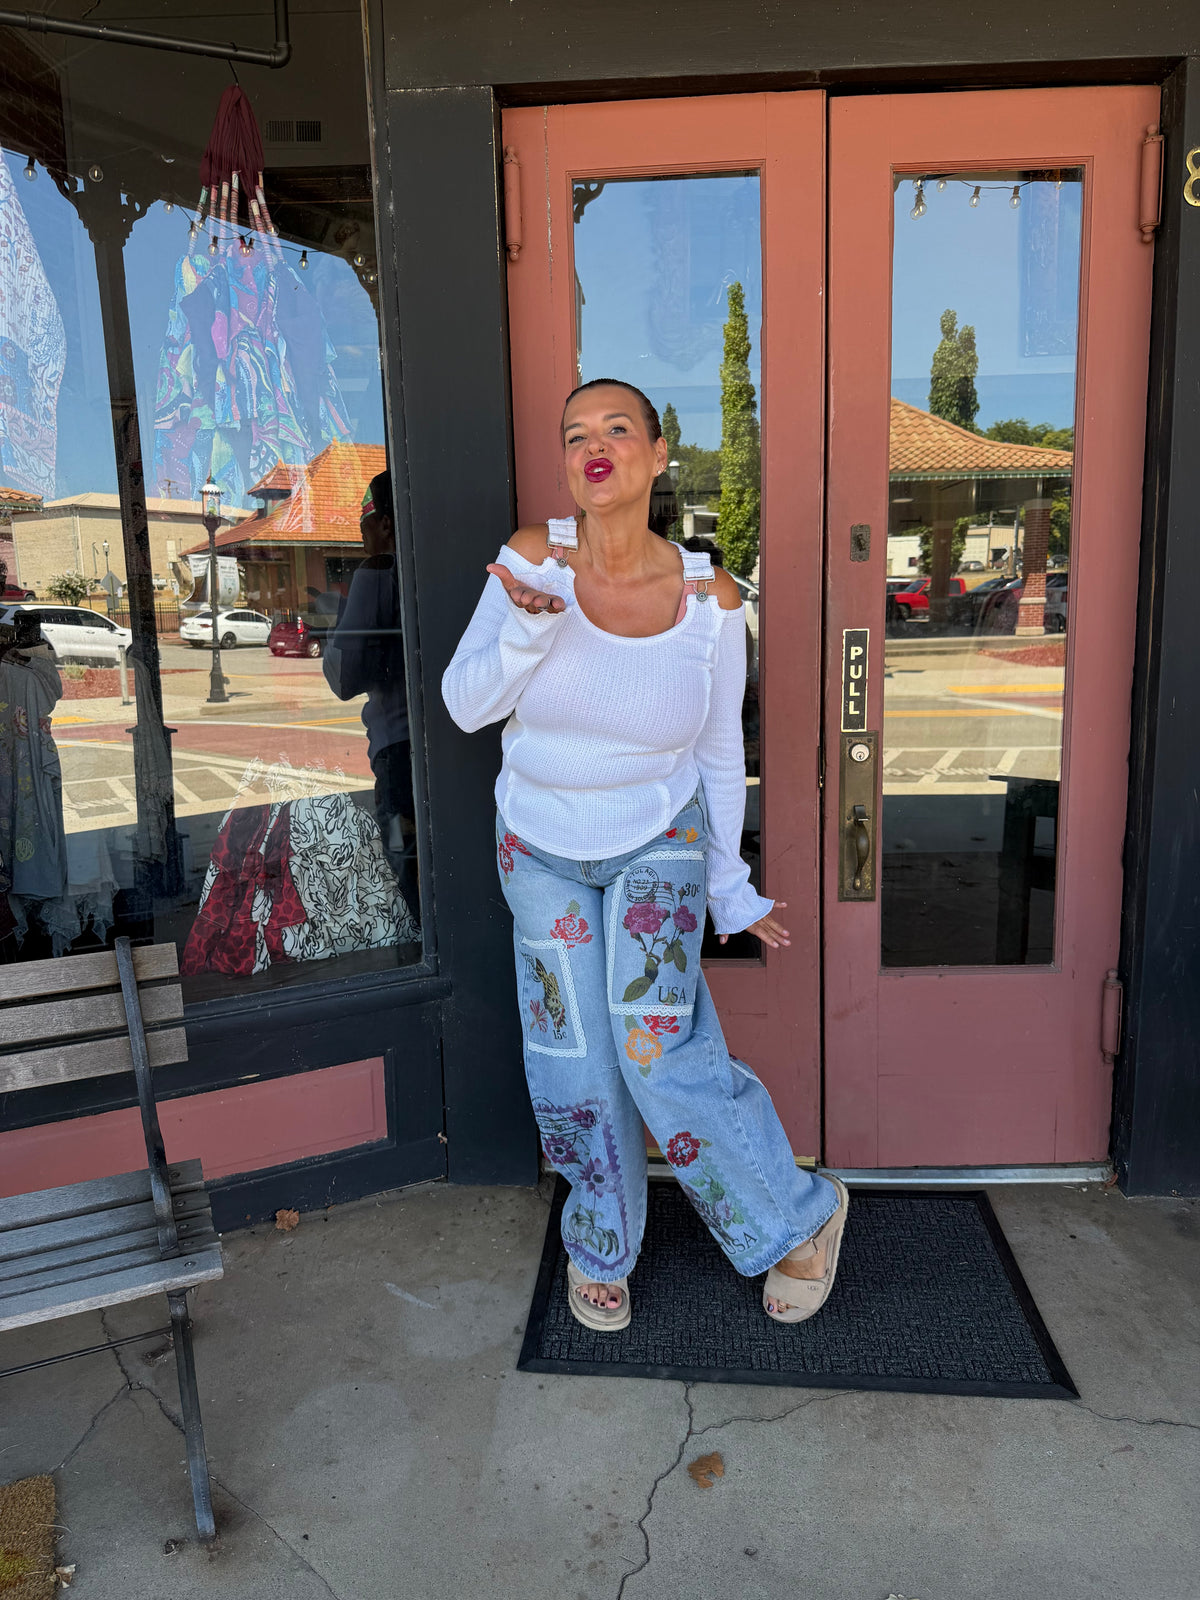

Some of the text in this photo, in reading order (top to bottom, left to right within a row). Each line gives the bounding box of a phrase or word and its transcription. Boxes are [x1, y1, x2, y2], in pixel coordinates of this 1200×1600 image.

[848, 646, 863, 715] PULL
[658, 986, 687, 1004] USA
[720, 1231, 758, 1255] USA
